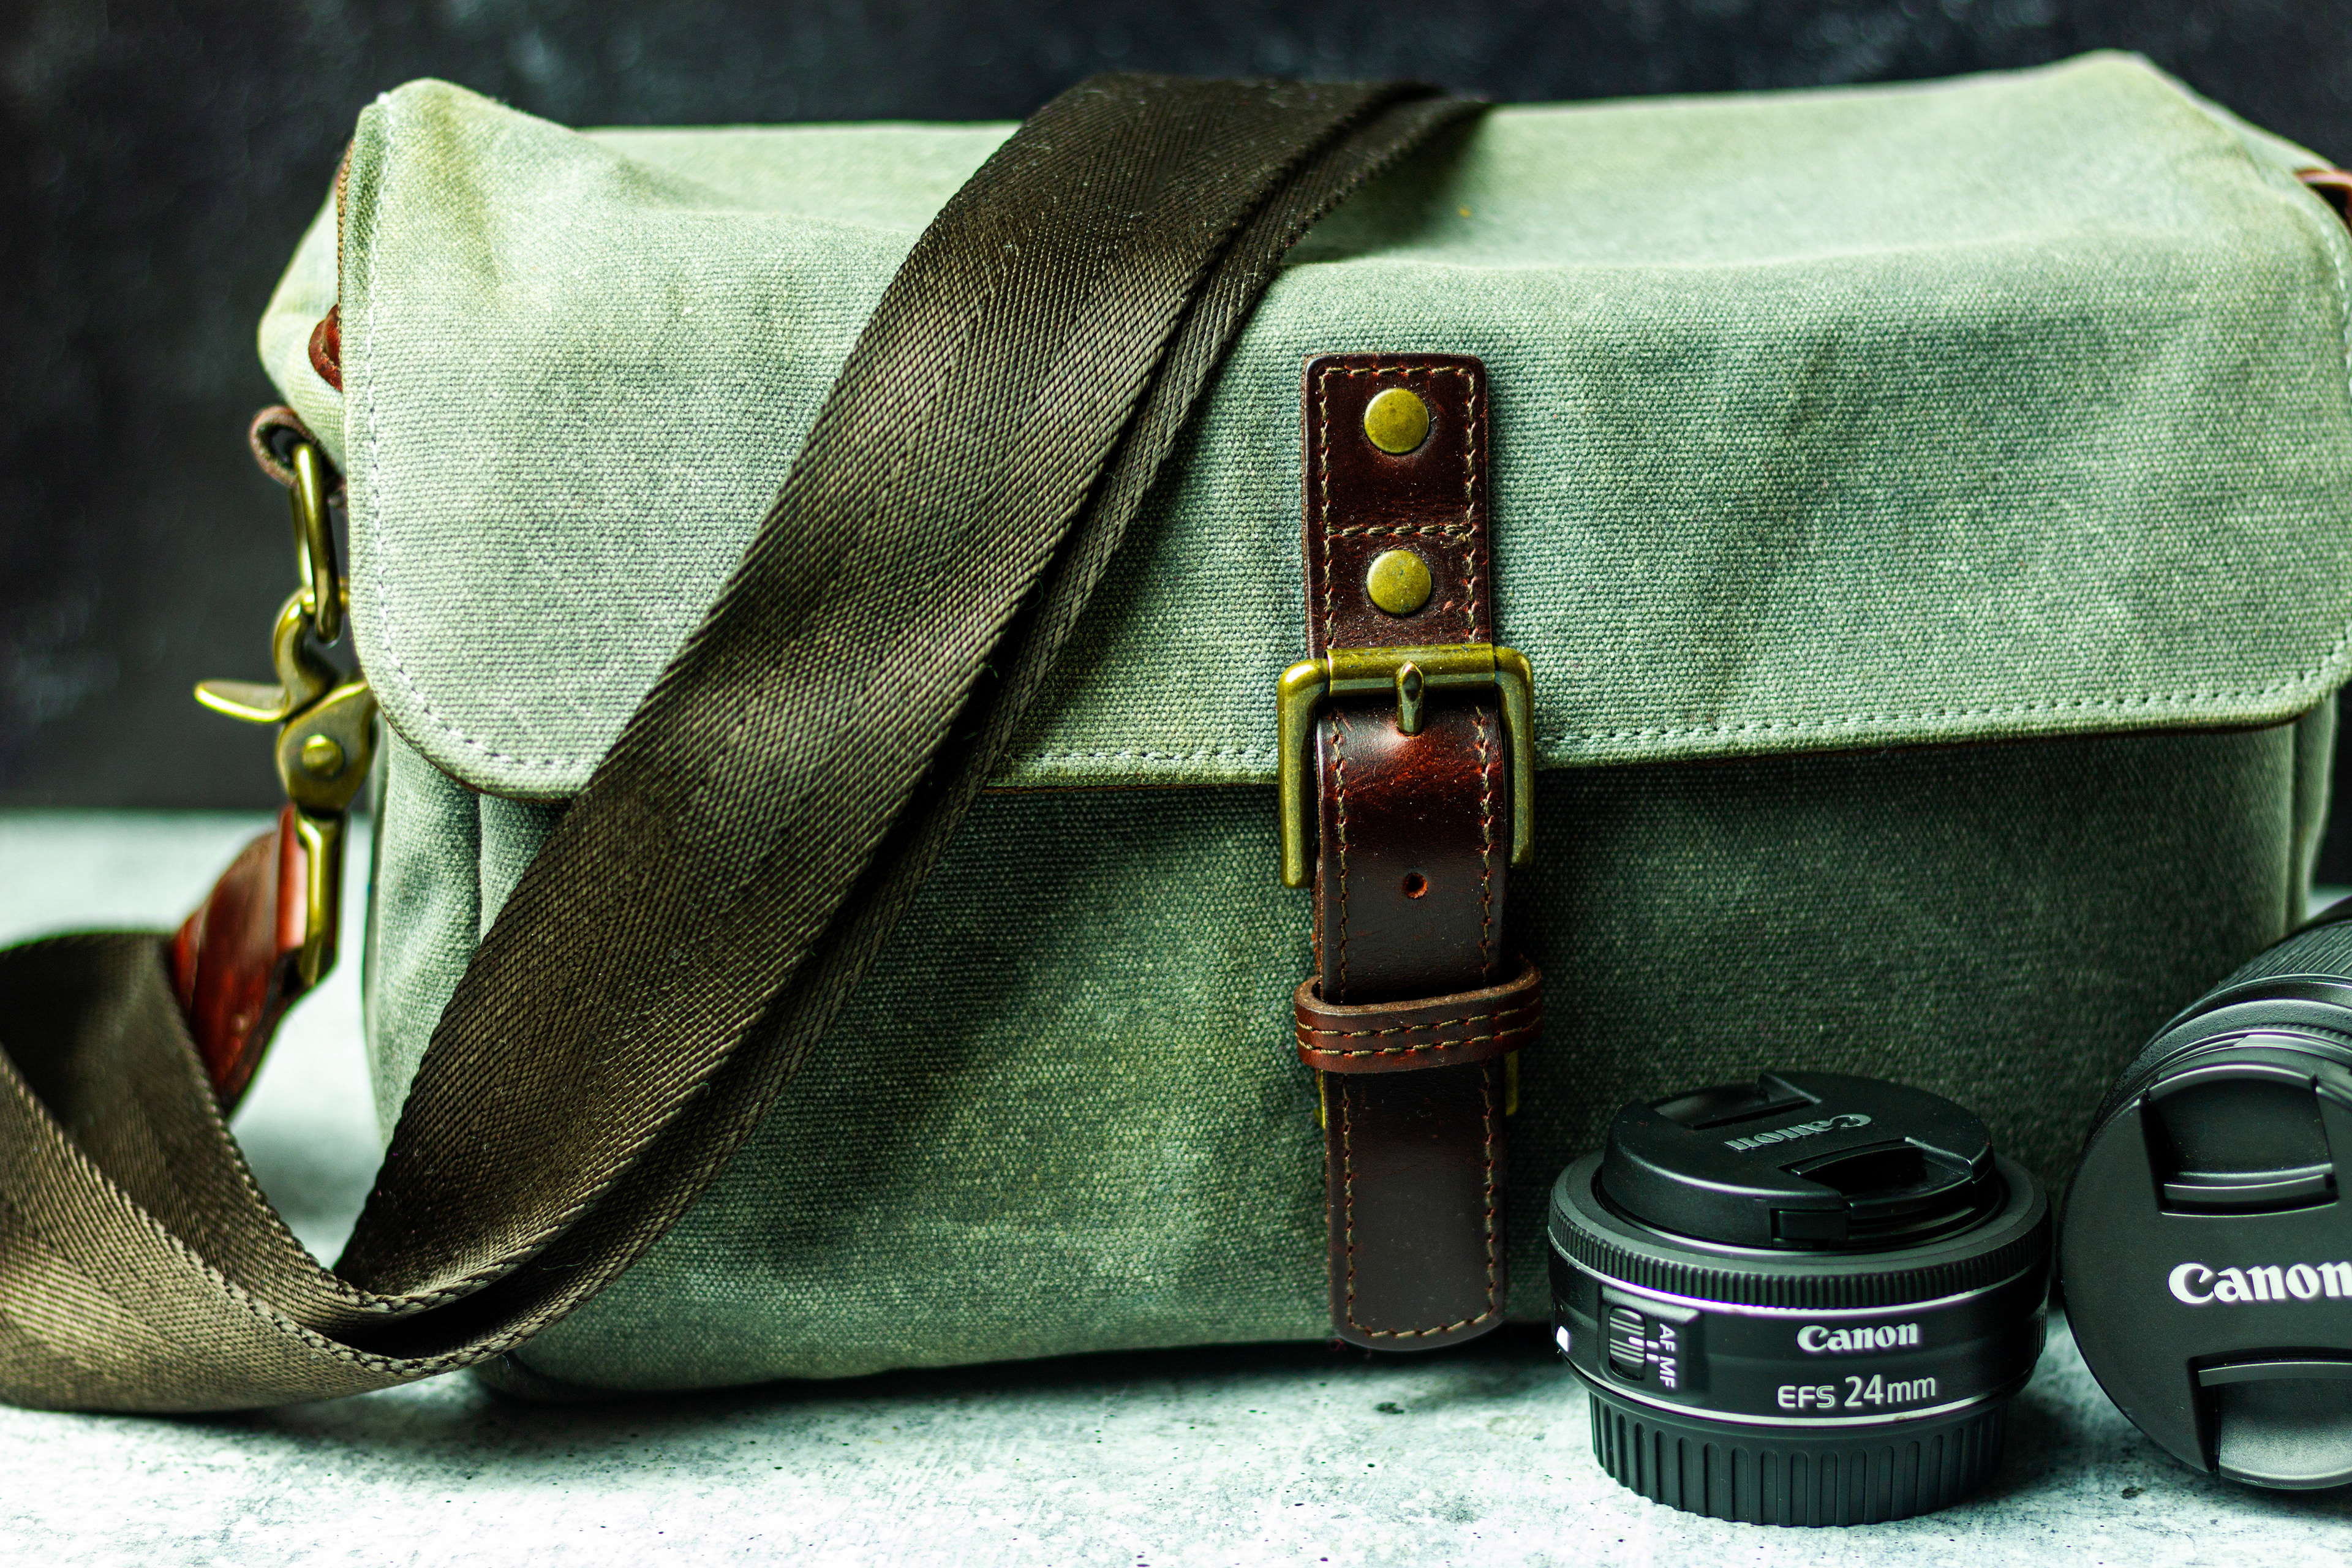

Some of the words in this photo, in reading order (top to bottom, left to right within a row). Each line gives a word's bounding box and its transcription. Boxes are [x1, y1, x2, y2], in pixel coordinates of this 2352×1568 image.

[1724, 1113, 1872, 1151] Canon
[2168, 1261, 2352, 1304] Canon
[1659, 1323, 1676, 1352] AF
[1796, 1322, 1918, 1352] Canon
[1659, 1355, 1676, 1389] MF
[1777, 1385, 1836, 1408] EFS
[1844, 1374, 1936, 1407] 24mm
